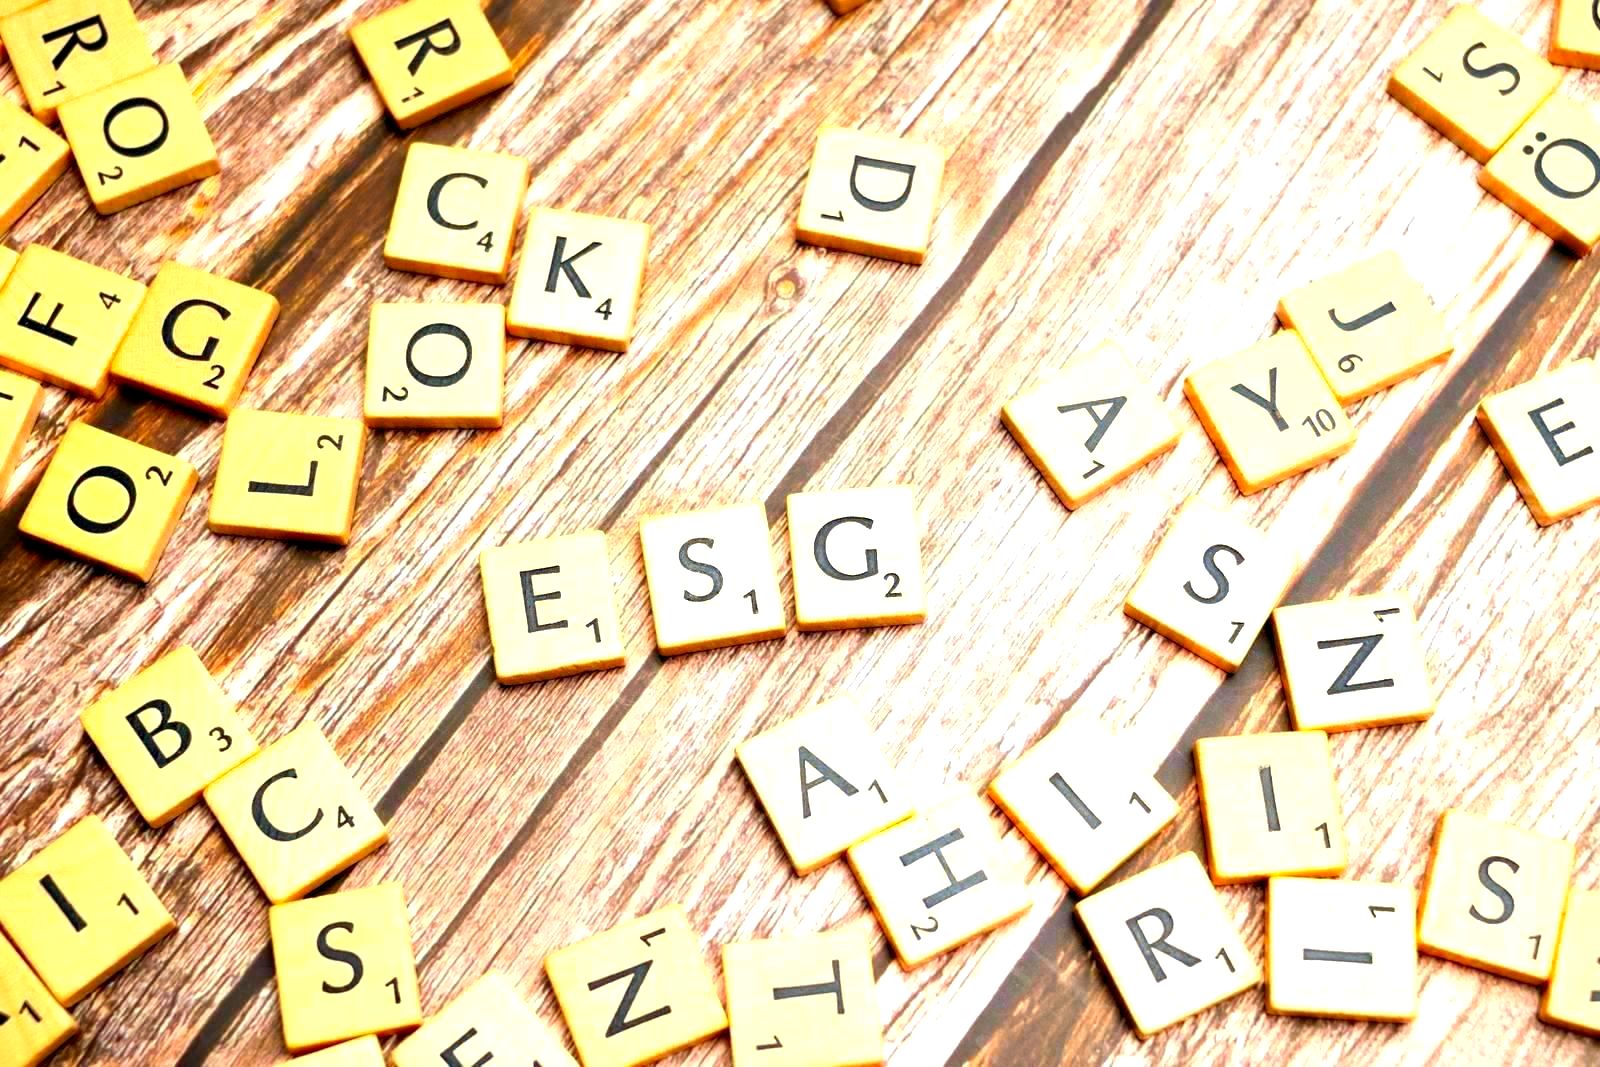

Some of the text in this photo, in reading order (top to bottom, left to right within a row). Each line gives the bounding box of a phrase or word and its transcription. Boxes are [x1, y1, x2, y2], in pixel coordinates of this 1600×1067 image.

[42, 14, 108, 96] R 1
[394, 18, 461, 103] R 1
[1423, 42, 1520, 96] S 1
[19, 136, 40, 152] 1
[98, 97, 169, 185] O 2
[1523, 132, 1600, 199] Ö
[427, 173, 493, 252] C 4
[821, 155, 916, 222] D 1
[544, 236, 612, 320] K 4
[17, 292, 121, 346] F 4
[161, 299, 231, 390] G 2
[1328, 302, 1396, 373] J 6
[382, 323, 472, 402] O 2
[1057, 396, 1127, 479] A 1
[1230, 367, 1336, 437] Y 10
[1528, 398, 1594, 467] E
[67, 466, 173, 534] O 2
[248, 435, 343, 496] L 2
[520, 516, 902, 643] E 1 S 1 G 2
[1183, 544, 1245, 644] S 1
[1373, 608, 1400, 622] 1
[125, 699, 232, 768] B 3
[251, 768, 355, 842] C 4
[799, 746, 888, 819] A 1
[1129, 792, 1151, 813] 1
[1315, 823, 1331, 848] 1
[117, 893, 139, 915] 1
[899, 828, 987, 940] H 2
[1368, 906, 1395, 918] 1
[1469, 856, 1541, 960] S 1
[317, 921, 401, 1004] S 1
[640, 928, 666, 947] 1
[1126, 908, 1235, 983] R 1
[19, 1000, 42, 1023] 1
[756, 960, 845, 1050] T 1
